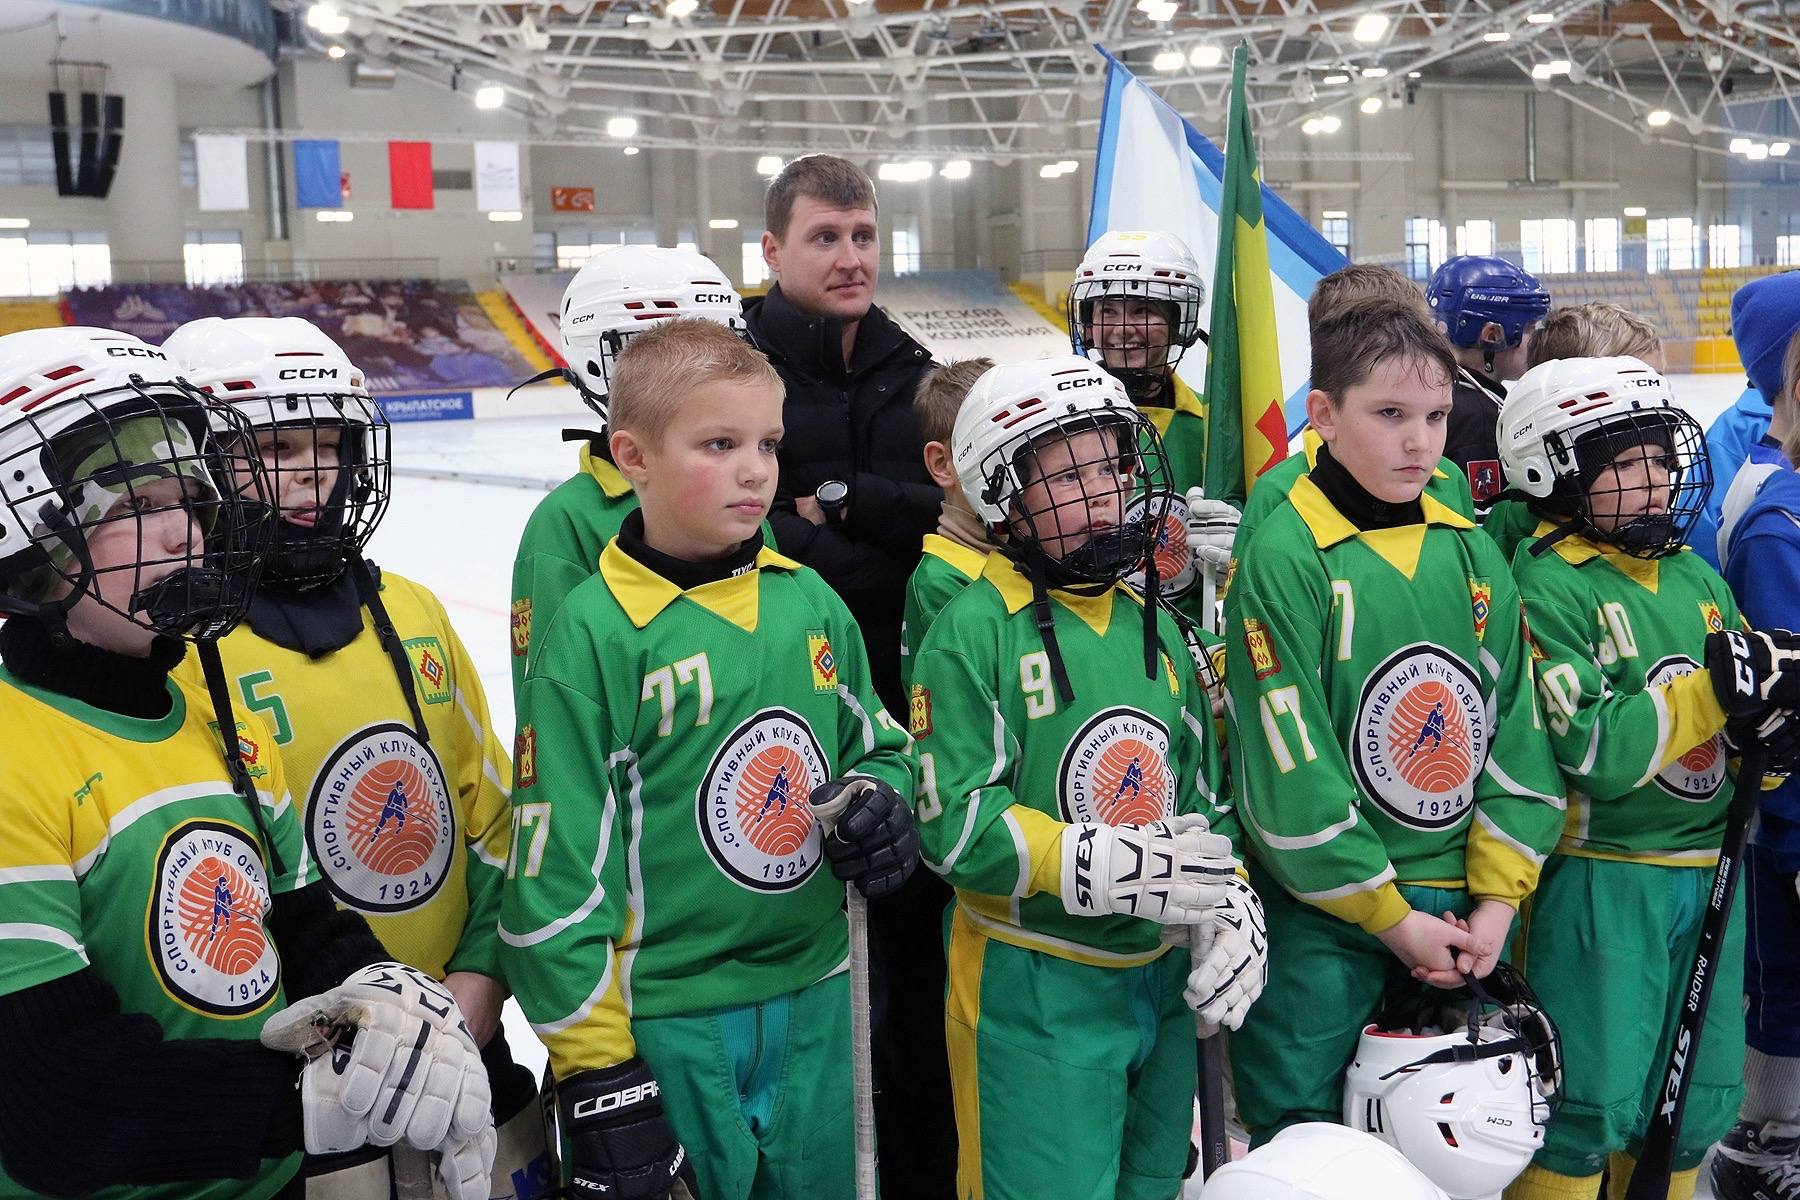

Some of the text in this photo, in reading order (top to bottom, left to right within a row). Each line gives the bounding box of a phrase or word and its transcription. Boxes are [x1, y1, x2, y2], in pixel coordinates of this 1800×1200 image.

[694, 294, 732, 303] CCM
[572, 313, 595, 325] CCM
[903, 308, 1004, 320] РУССКАЯ
[915, 318, 1012, 331] МЕДНАЯ
[926, 327, 1053, 340] КОМПАНИЯ
[106, 347, 168, 361] CCM
[278, 368, 338, 380] CCM
[1057, 377, 1103, 392] CCM
[1513, 423, 1533, 440] CCM
[958, 442, 973, 462] CCM
[641, 651, 714, 737] 77
[1020, 650, 1057, 720] 9
[1259, 685, 1318, 774] 17
[1367, 662, 1482, 778] СПОРТИВНЫЙ КЛУБ ОБУХОВО
[1074, 724, 1119, 823] СПОРТИВНЫЙ
[1122, 722, 1154, 741] КЛУБ
[1684, 773, 1717, 790] 1924
[715, 729, 766, 844] СПОРТИВНЫЙ
[772, 726, 801, 745] КЛУБ
[323, 740, 449, 869] СПОРТИВНЫЙ КЛУБ ОБУХОВО
[1417, 794, 1464, 816] 1924
[763, 854, 807, 879] 1924
[1075, 824, 1098, 910] STEX
[379, 872, 432, 900] 1924
[163, 840, 201, 973] СПОРТИВНЫЙ
[228, 969, 270, 1002] 1924
[1687, 954, 1708, 1012] RAIDER
[1660, 1024, 1691, 1126] STEX
[1486, 1116, 1513, 1127] CCM
[572, 1177, 610, 1192] STEX
